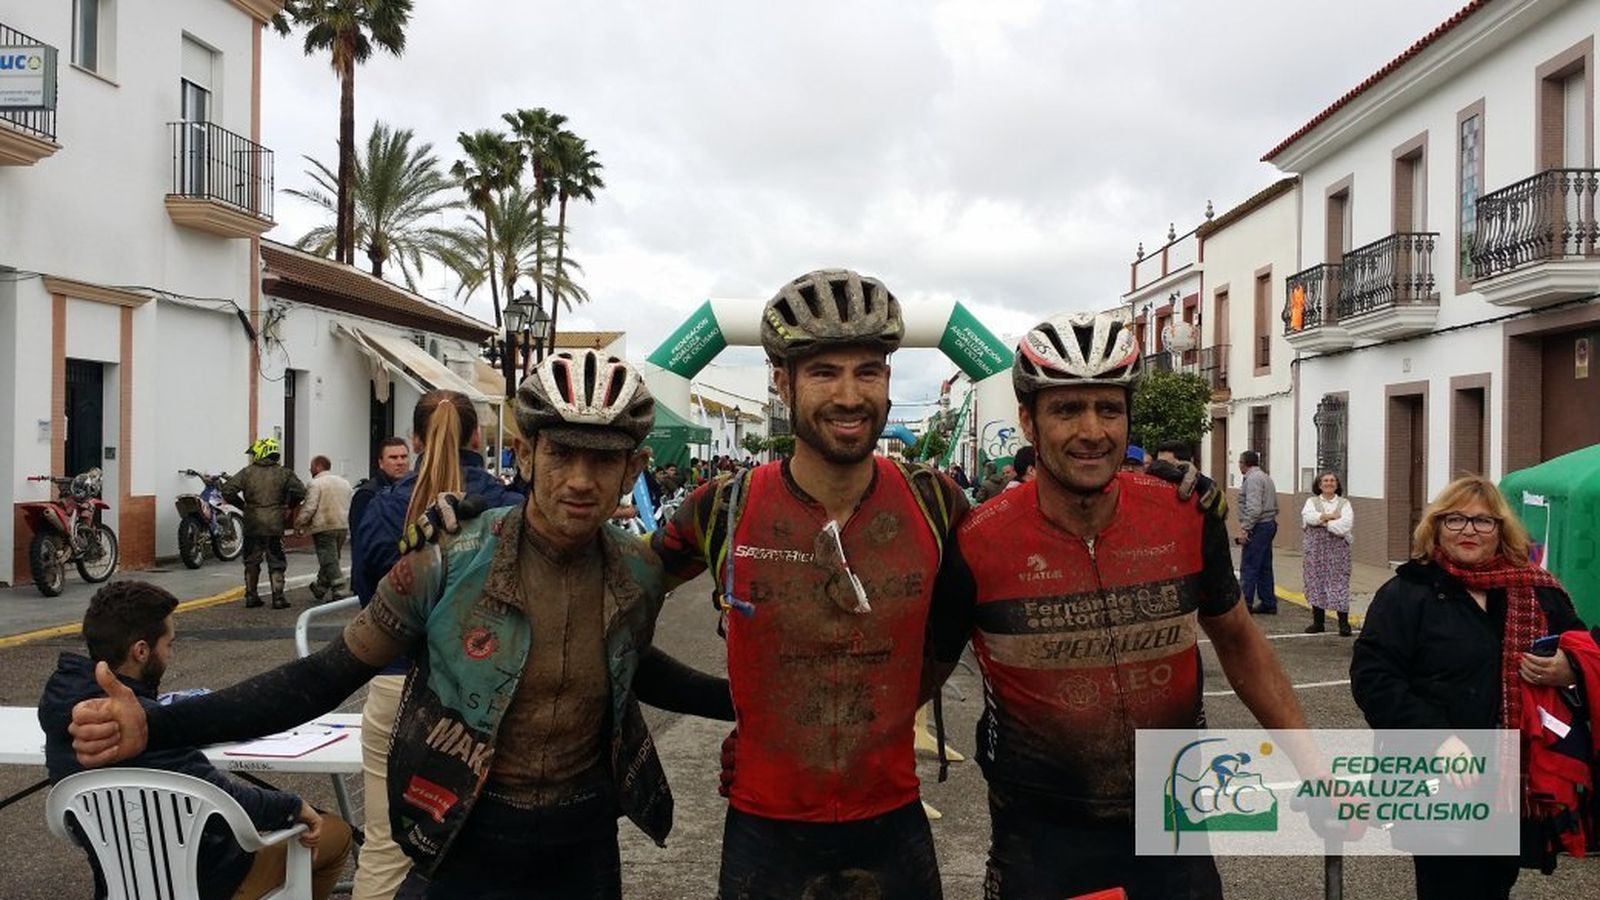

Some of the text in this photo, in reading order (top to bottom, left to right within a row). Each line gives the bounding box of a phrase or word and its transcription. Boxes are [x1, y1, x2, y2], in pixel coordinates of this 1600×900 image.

[668, 335, 700, 368] ANDALUZA
[682, 327, 720, 365] DE CICLISMO
[950, 325, 985, 358] ANDALUZA
[954, 339, 993, 376] DE CICLISMO
[1023, 592, 1134, 617] Fernando
[1040, 624, 1181, 660] SPECIALIZED
